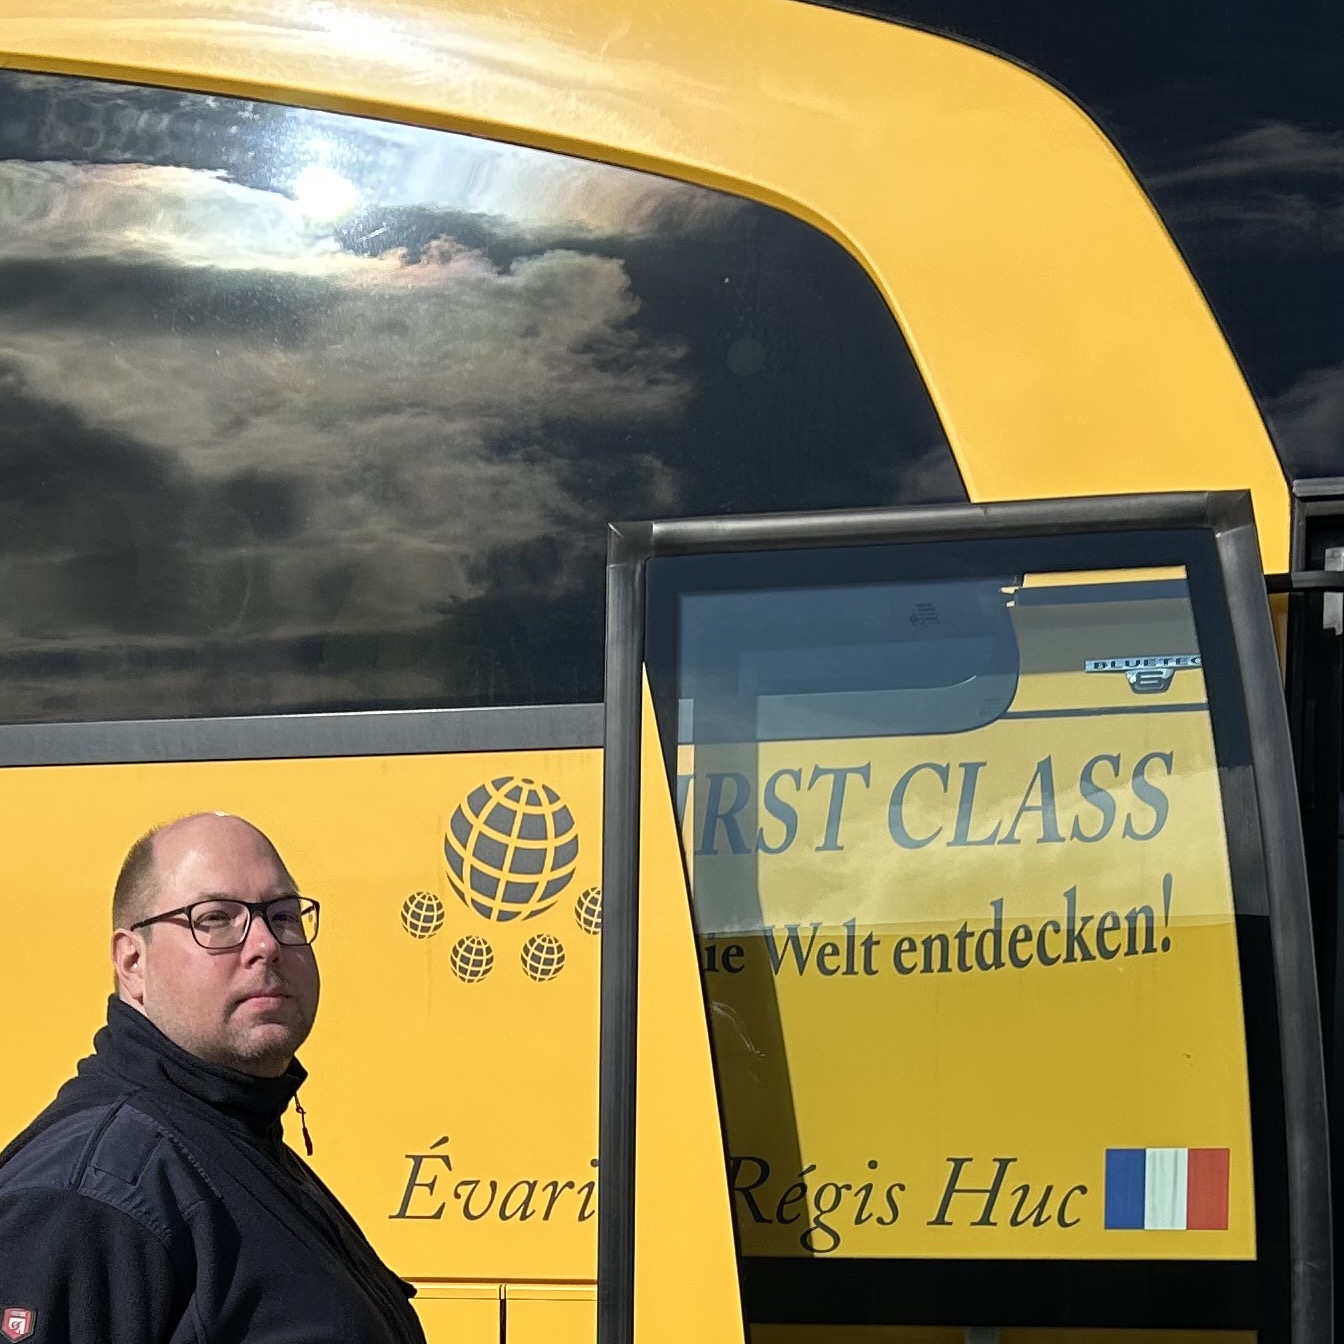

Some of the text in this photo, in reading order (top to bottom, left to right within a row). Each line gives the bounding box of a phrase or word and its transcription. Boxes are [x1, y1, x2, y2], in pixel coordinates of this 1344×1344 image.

[888, 750, 1175, 850] CLASS
[704, 871, 1173, 977] ie Welt entdecken!
[387, 1136, 1089, 1254] Évari Régis Huc
